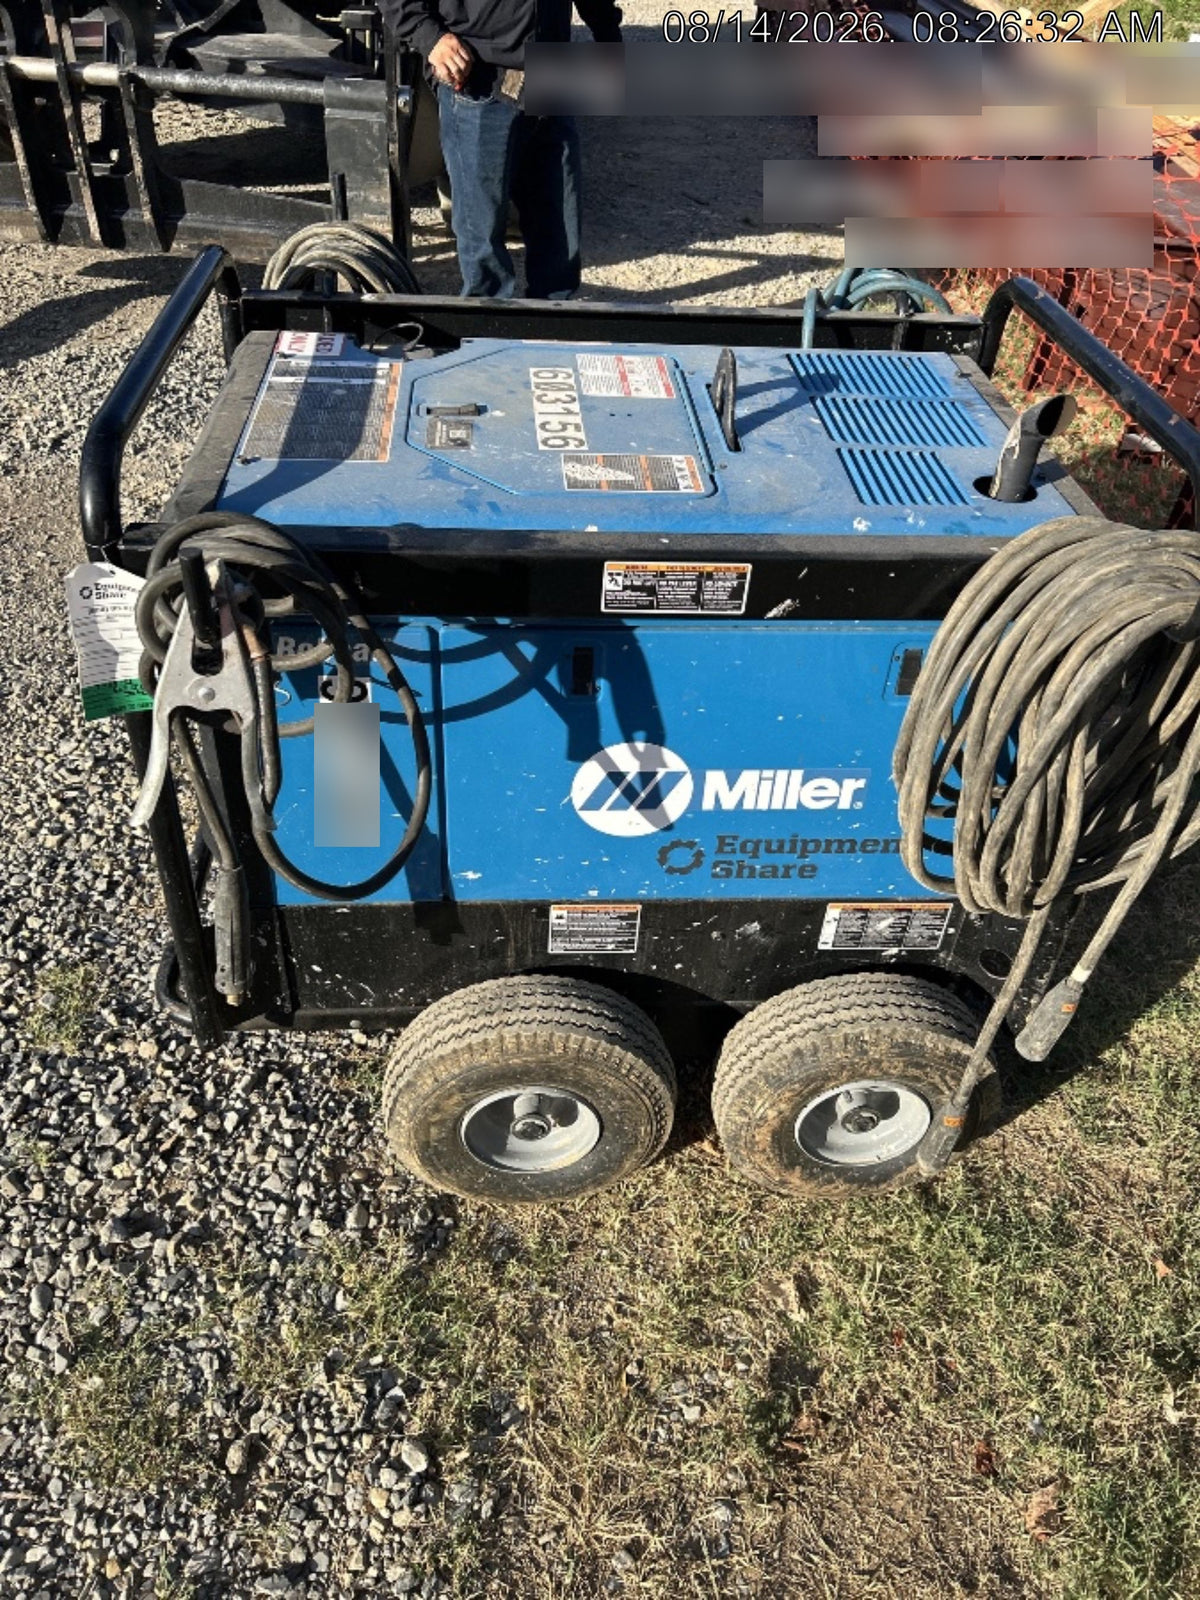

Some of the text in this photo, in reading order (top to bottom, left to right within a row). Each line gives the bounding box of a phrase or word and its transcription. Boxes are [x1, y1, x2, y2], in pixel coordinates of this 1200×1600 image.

[533, 369, 586, 448] 603156
[702, 769, 866, 811] Miller
[714, 833, 901, 859] Equipmen
[710, 860, 818, 879] Share
